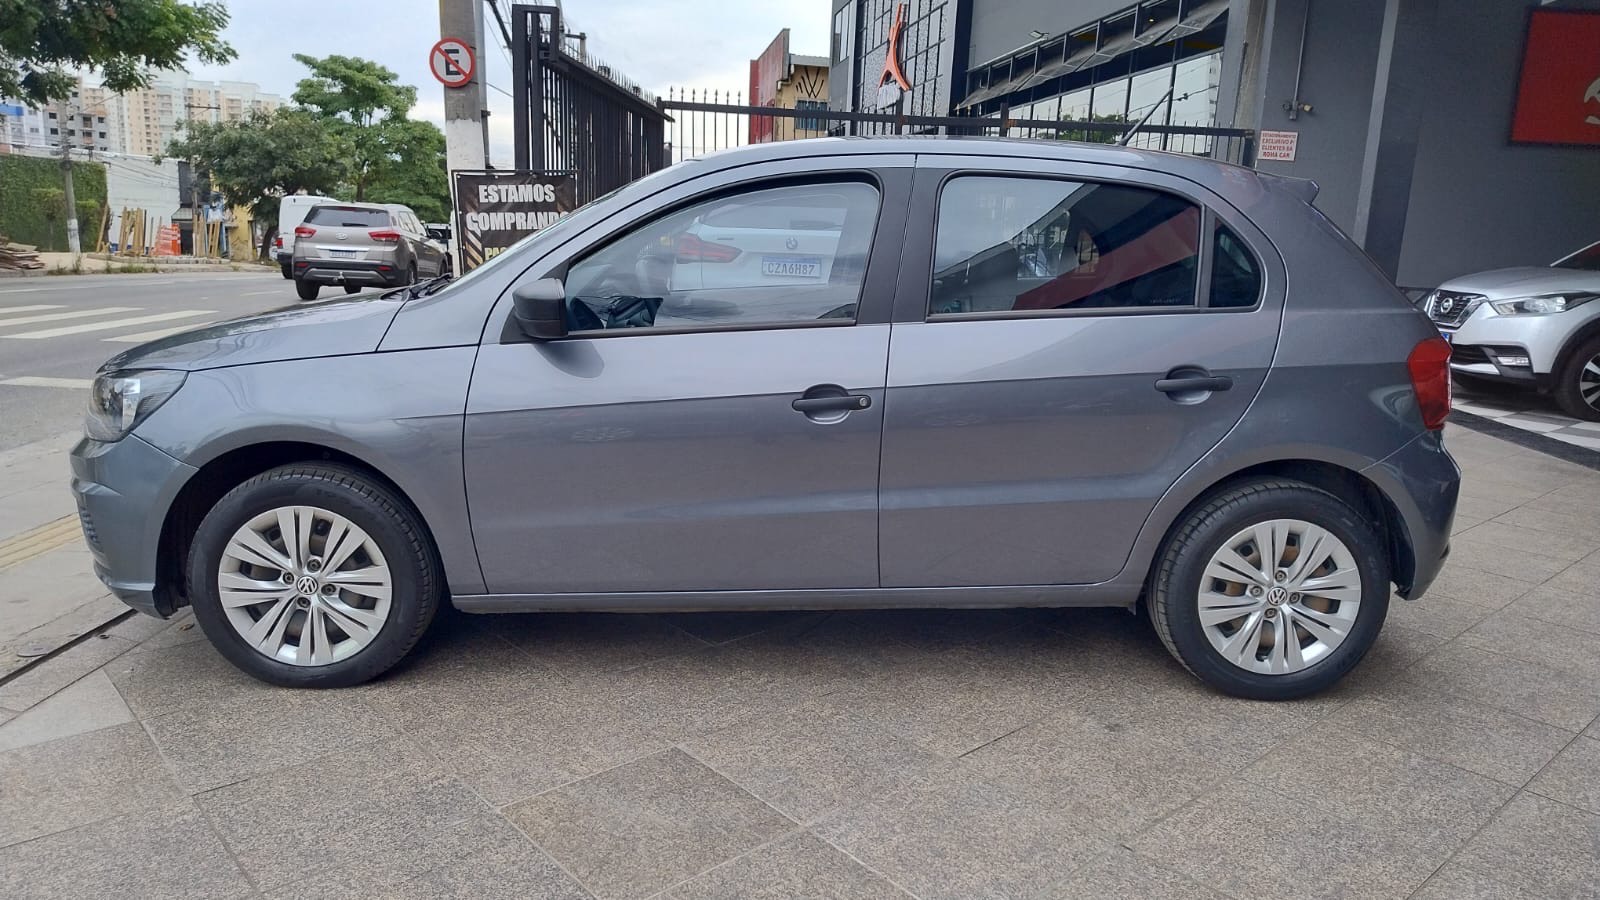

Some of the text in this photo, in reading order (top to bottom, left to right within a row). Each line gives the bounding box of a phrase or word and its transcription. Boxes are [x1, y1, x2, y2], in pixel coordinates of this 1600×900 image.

[445, 48, 461, 75] E
[478, 184, 556, 203] ESTAMOS
[767, 262, 815, 275] CZA6H87
